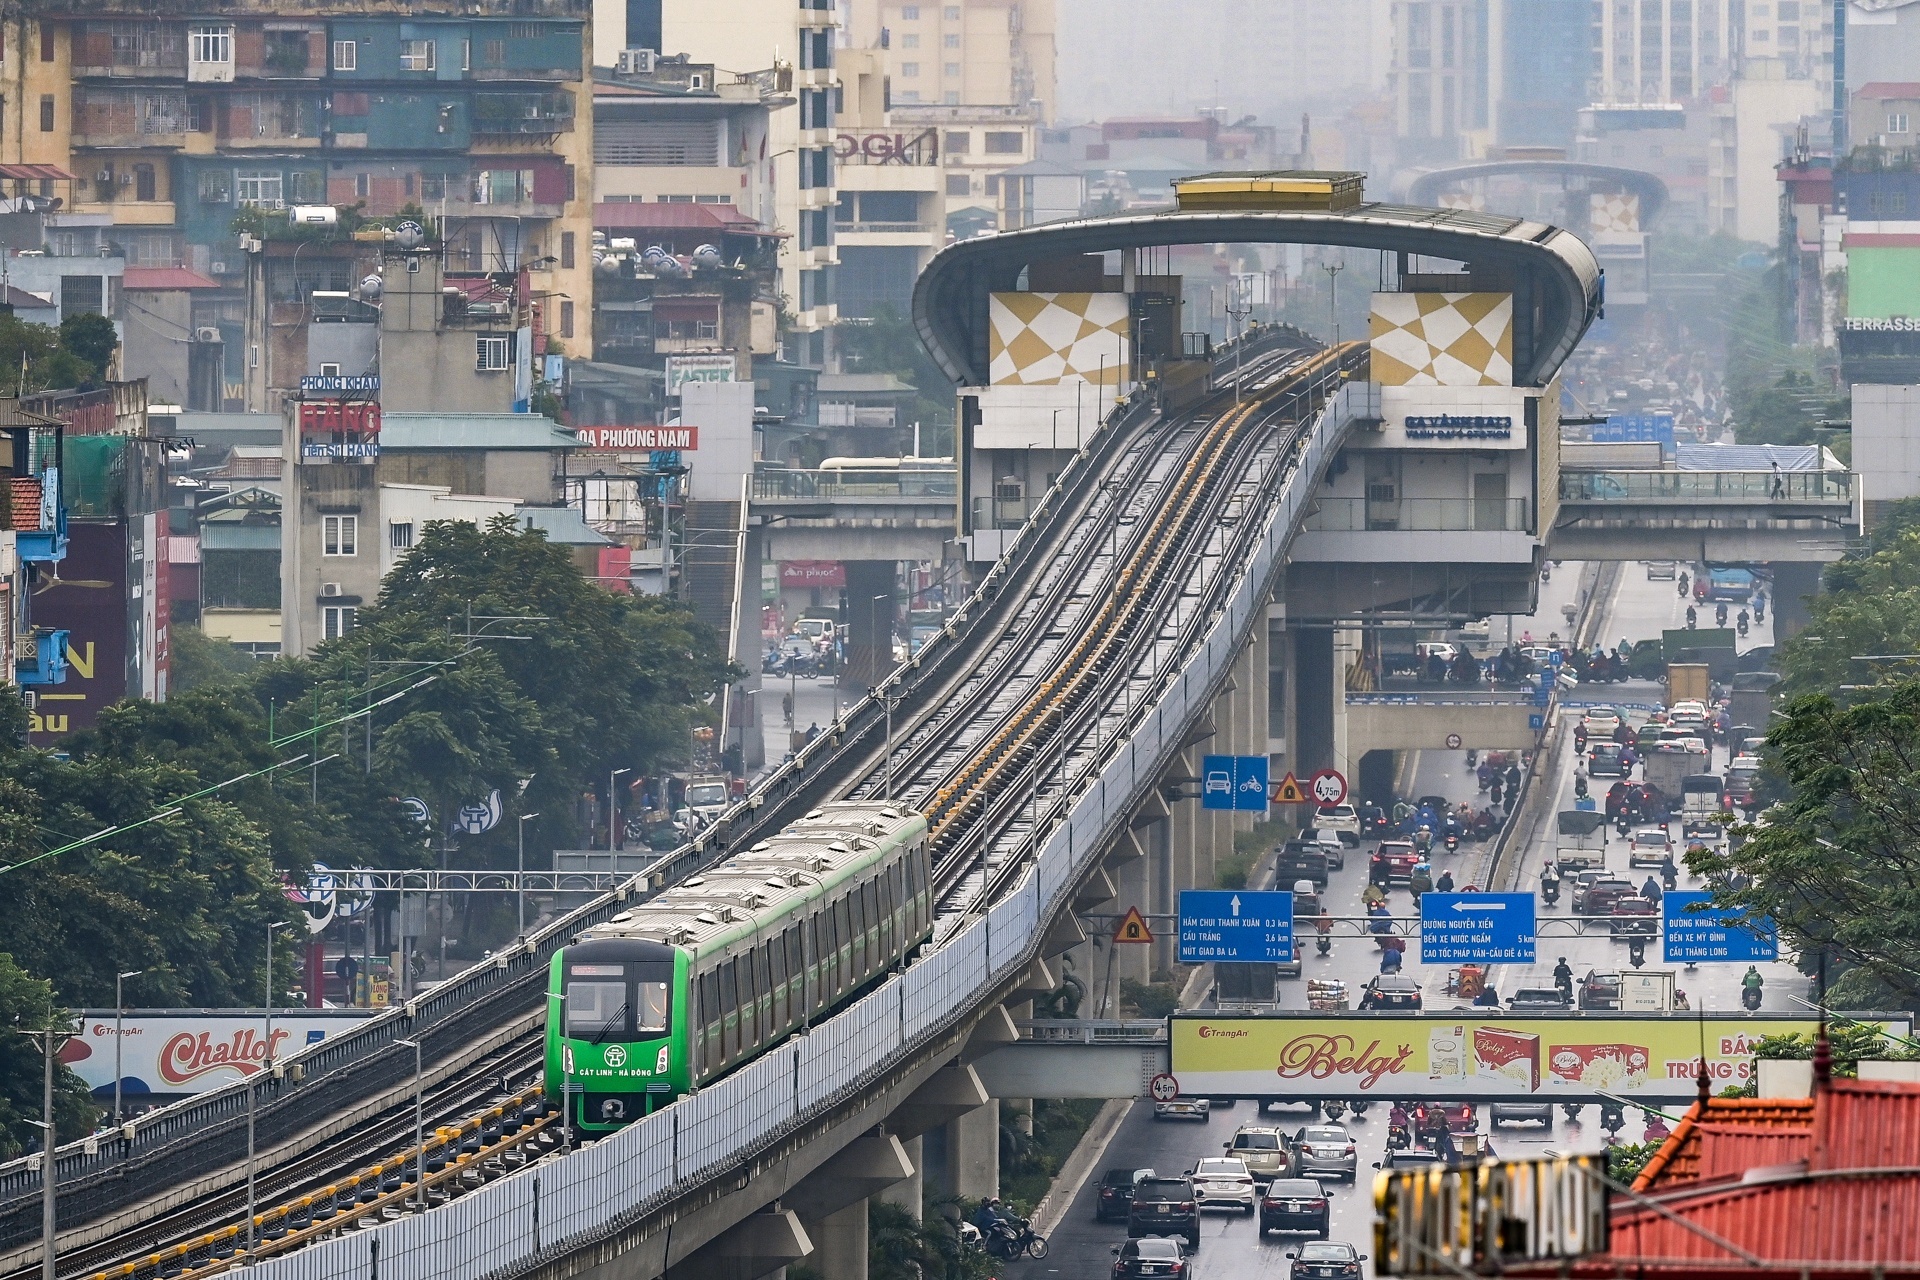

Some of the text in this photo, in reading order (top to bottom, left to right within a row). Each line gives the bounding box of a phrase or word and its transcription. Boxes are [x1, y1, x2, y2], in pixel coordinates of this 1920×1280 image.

[577, 430, 597, 447] OA
[658, 430, 690, 448] NAM
[1218, 919, 1240, 927] THANH
[1242, 918, 1260, 927] XUÂN
[1278, 919, 1288, 928] km
[1670, 918, 1692, 927] ĐƯỜNG
[1278, 934, 1288, 942] km
[1424, 932, 1436, 943] BẾN
[1440, 935, 1448, 943] XE
[1451, 933, 1469, 943] NƯỚC
[1518, 935, 1522, 943] 5
[1524, 935, 1534, 943] km
[1670, 931, 1682, 942] BẾN
[1686, 934, 1693, 942] XE
[1697, 932, 1706, 942] MỸ
[1710, 932, 1726, 942] ĐÌNH
[1183, 945, 1196, 956] NÚT
[1199, 947, 1214, 956] GIAO
[1217, 947, 1226, 956] BA
[1229, 948, 1237, 956] LA
[1278, 948, 1288, 956] km
[1424, 949, 1436, 958] CAO
[1439, 946, 1451, 958] TỐC
[1453, 947, 1470, 958] PHÁP
[1710, 948, 1727, 956] LONG
[1751, 948, 1759, 956] 14
[1761, 948, 1772, 956] km
[1476, 1039, 1505, 1055] Belgi
[159, 1028, 290, 1084] Challot
[1277, 1034, 1414, 1090] Belgi
[580, 1068, 594, 1076] CÁT
